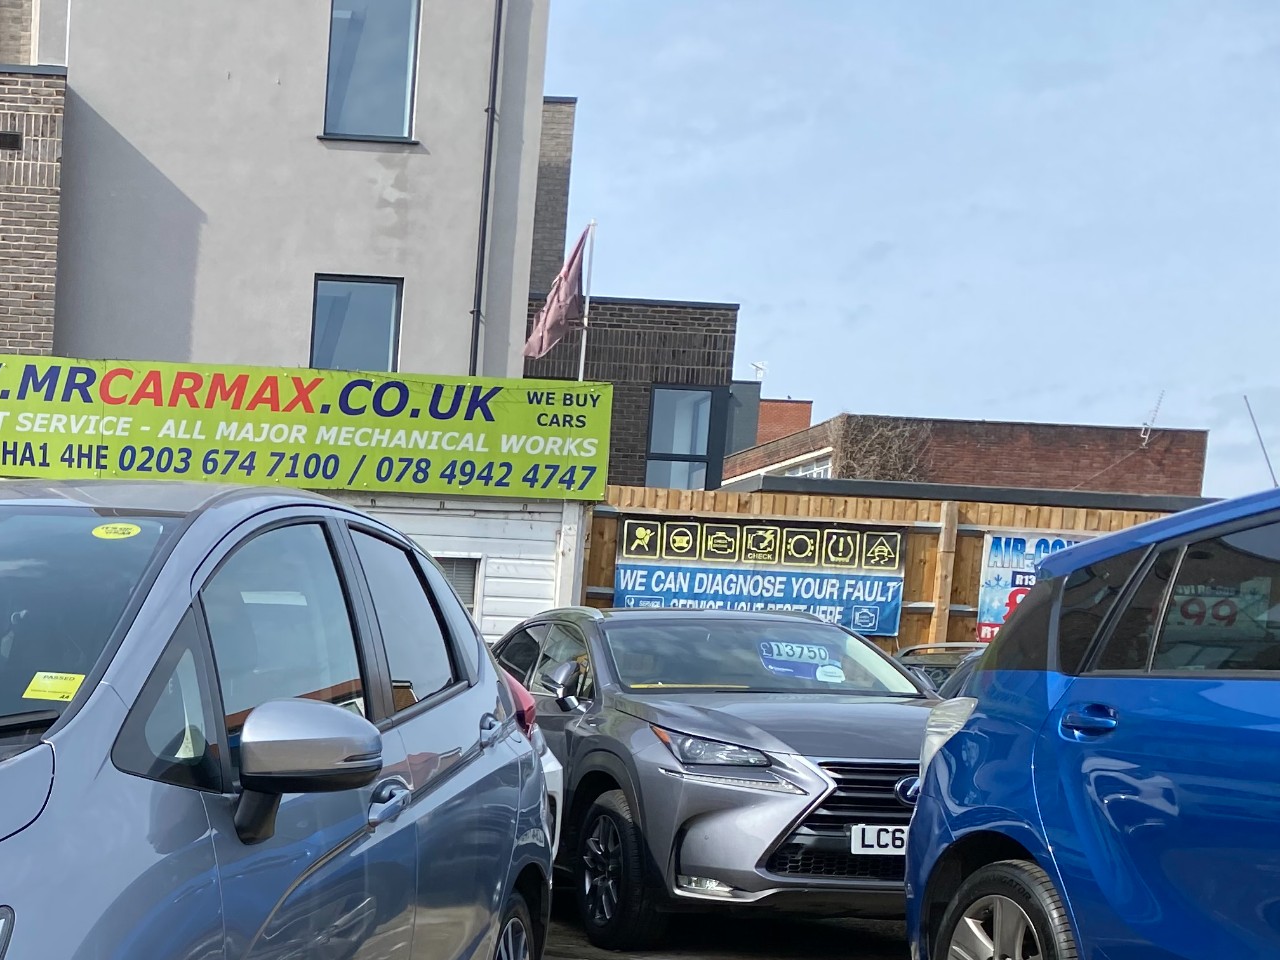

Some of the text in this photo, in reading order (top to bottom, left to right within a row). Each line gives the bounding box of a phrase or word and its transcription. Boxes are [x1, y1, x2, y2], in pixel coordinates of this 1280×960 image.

[527, 391, 601, 408] WE BUY
[537, 413, 587, 429] CARS
[16, 412, 132, 437] SERVICE
[157, 418, 206, 440] ALL
[215, 422, 308, 444] MAJOR
[315, 426, 490, 453] MECHANICAL
[501, 435, 598, 457] WORKS
[2, 441, 49, 467] HA1
[60, 444, 108, 471] 4HE
[119, 446, 192, 473] 0203
[201, 449, 256, 476] 674
[266, 452, 340, 480] 7100
[375, 456, 429, 484] 078
[439, 459, 513, 487] 4942
[522, 463, 597, 491] 4747
[620, 569, 899, 602] WE CAN DIAGNOSE YOUR FAULT
[810, 605, 844, 625] HERE
[861, 828, 905, 849] LC6
